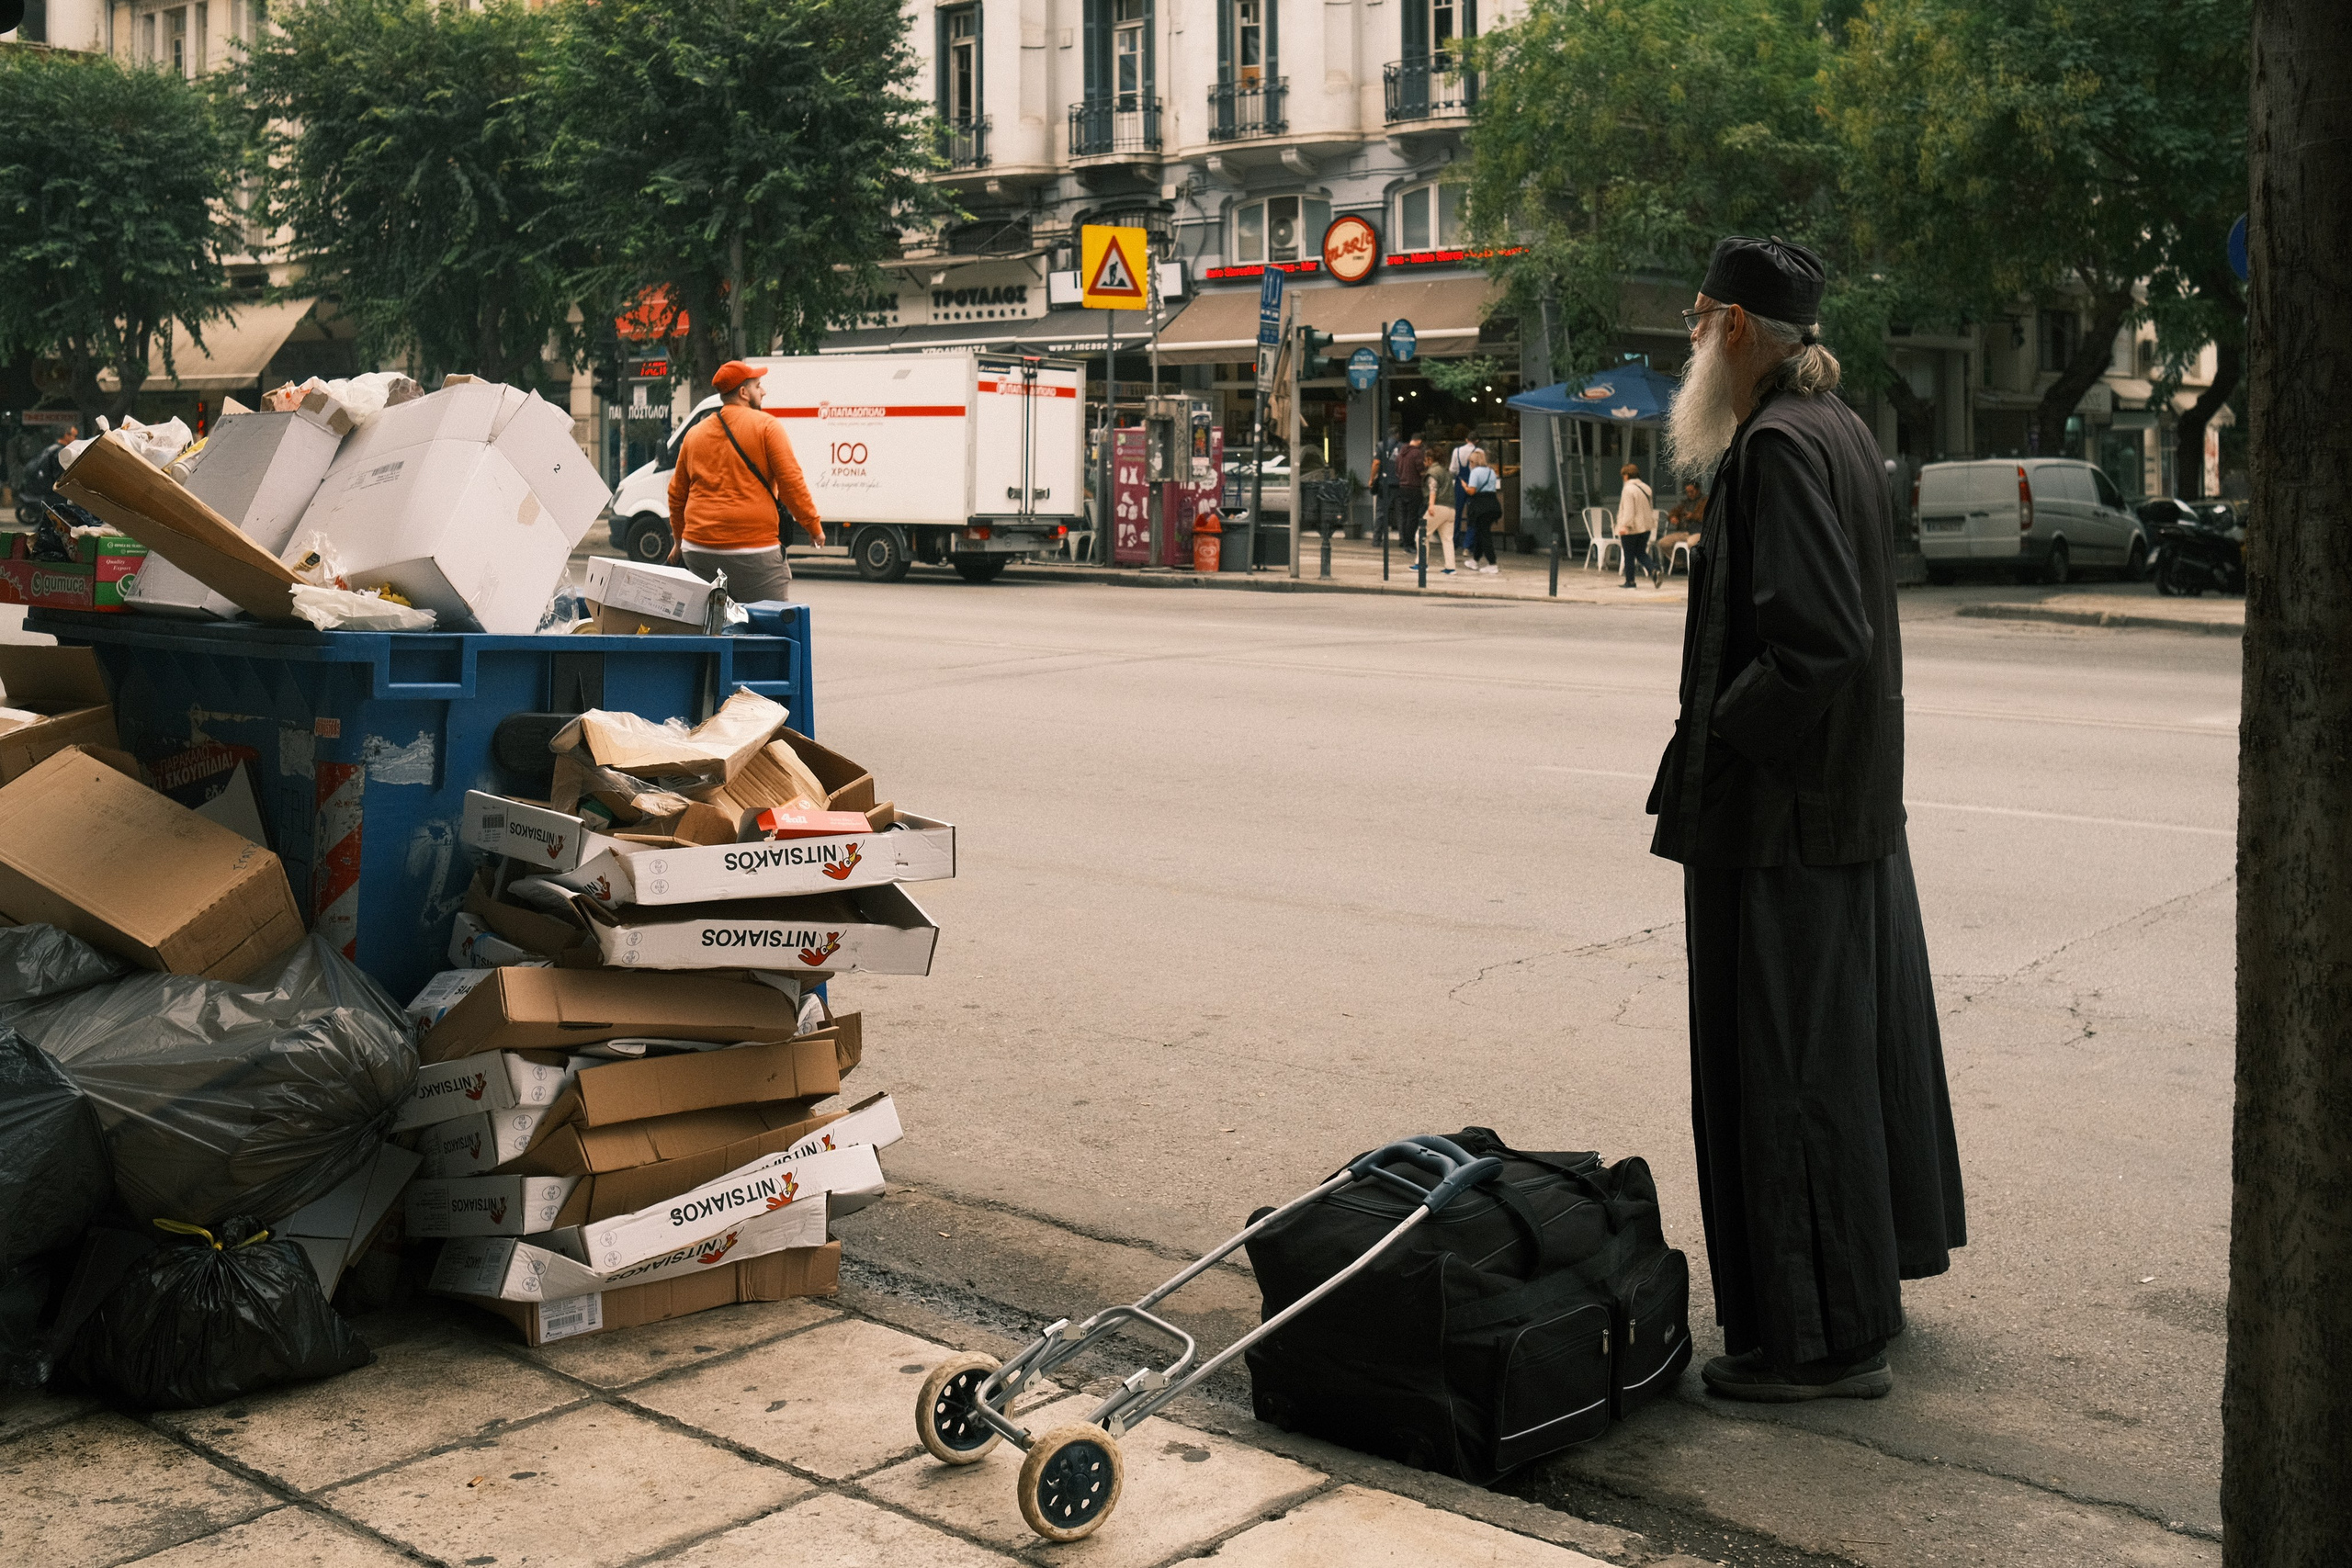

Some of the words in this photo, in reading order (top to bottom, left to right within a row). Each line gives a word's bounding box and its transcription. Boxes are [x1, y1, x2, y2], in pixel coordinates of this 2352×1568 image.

[831, 442, 868, 464] 100
[553, 463, 561, 474] 2
[42, 573, 85, 594] gumuca
[160, 745, 210, 773] ΠΑΡΑΚΑΛΩ
[165, 750, 233, 790] ΣΚΟΥΠΙΔΙΑ!
[509, 821, 556, 846] NITSIAKOS
[724, 844, 837, 871] NITSIAKOS
[701, 929, 817, 948] NITSIAKOS
[443, 1134, 474, 1155] NITSIAKOS
[451, 1197, 498, 1213] NITSIAKOS
[670, 1177, 777, 1227] NITSIAKOS
[604, 1237, 718, 1285] NITSIAKOS
